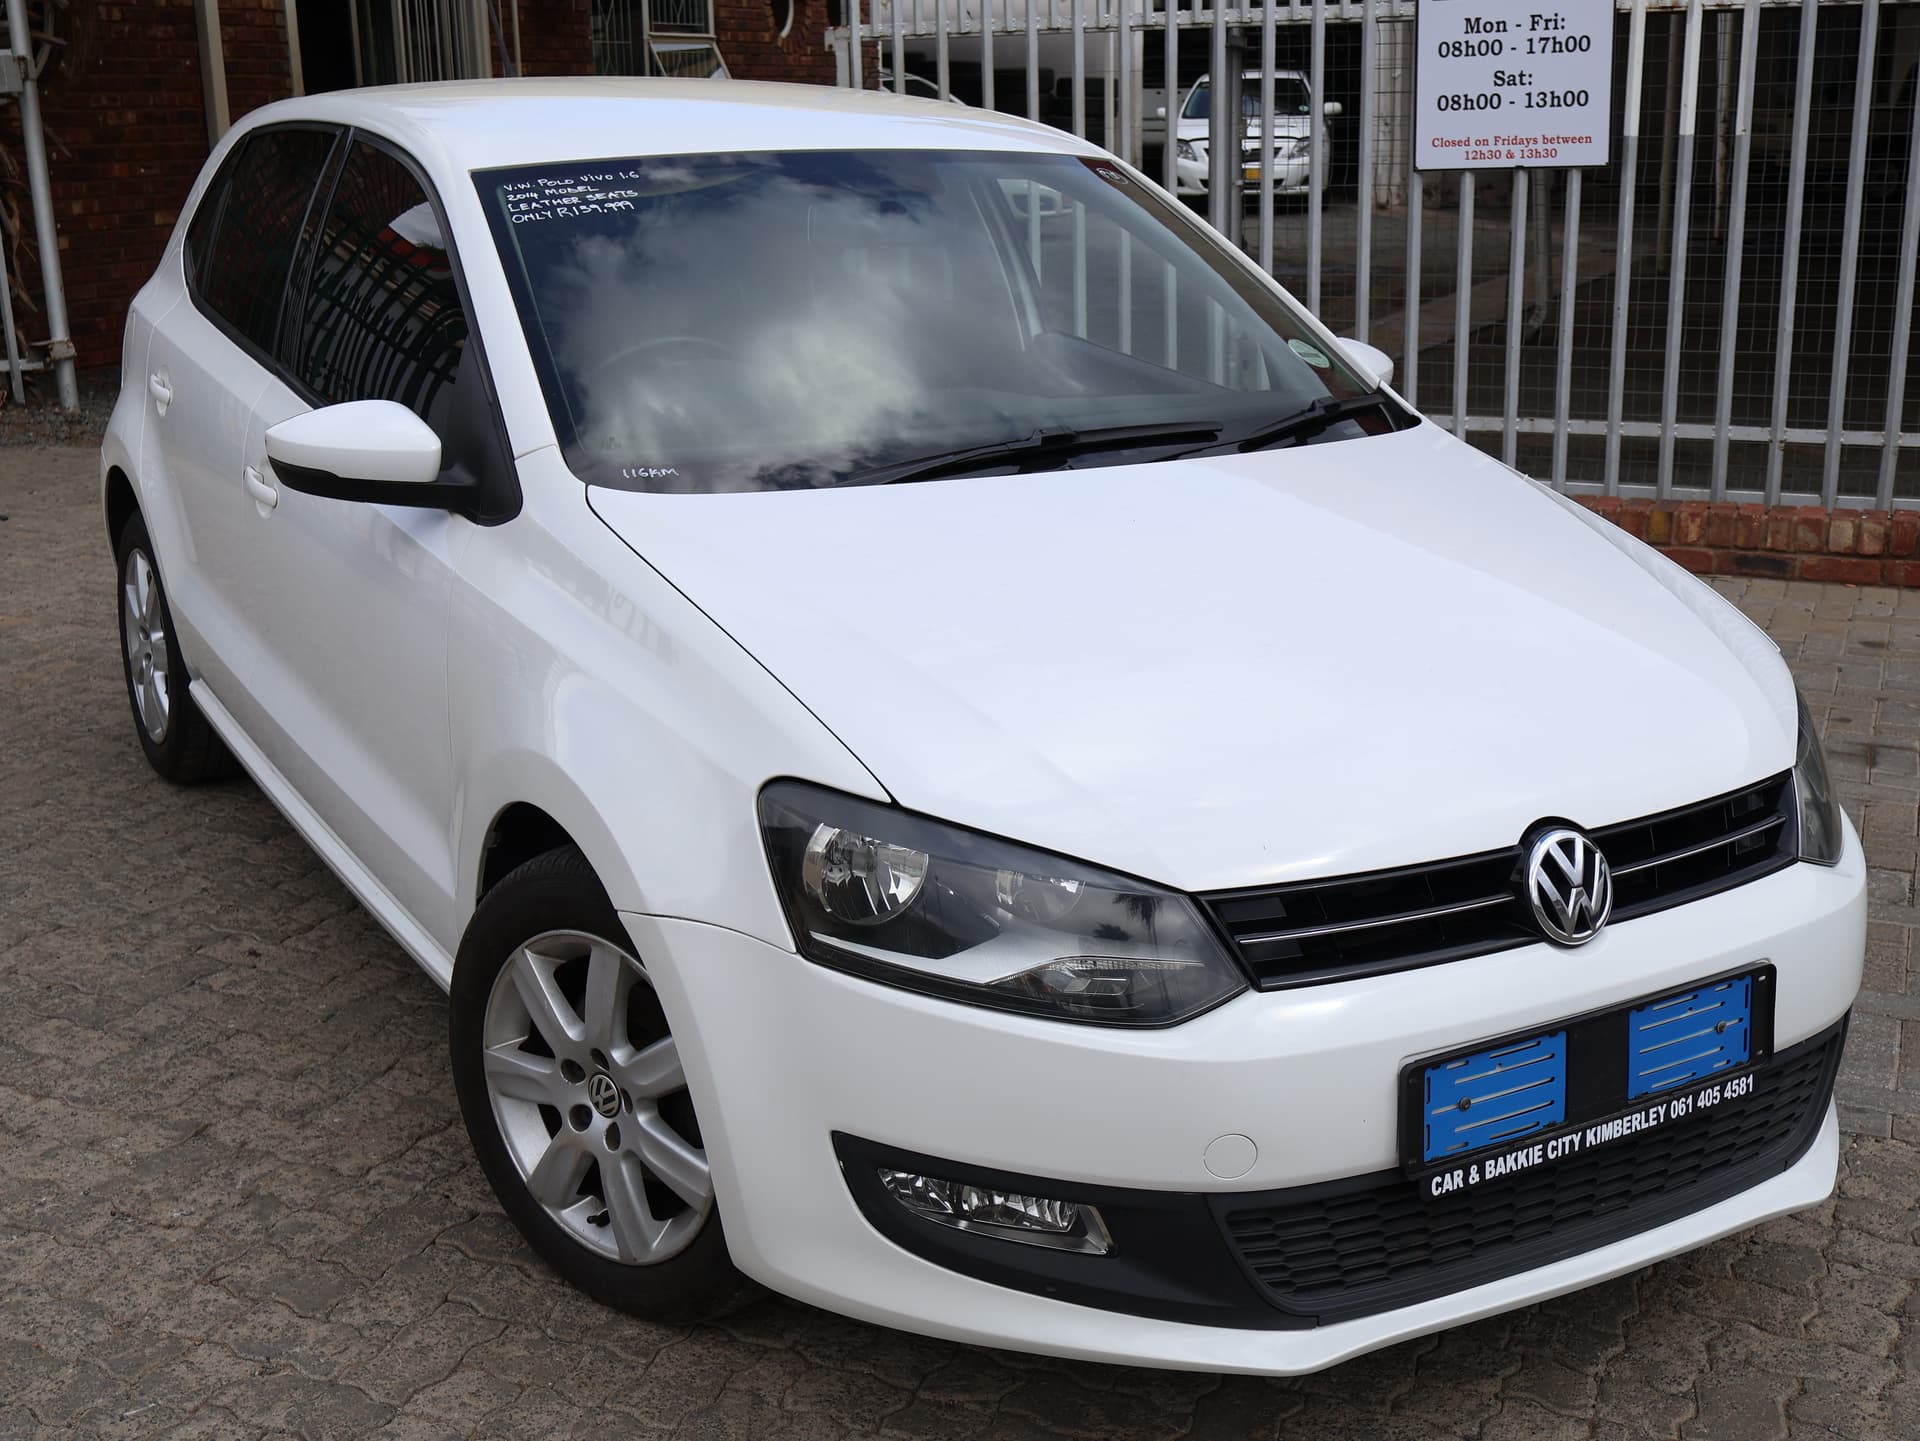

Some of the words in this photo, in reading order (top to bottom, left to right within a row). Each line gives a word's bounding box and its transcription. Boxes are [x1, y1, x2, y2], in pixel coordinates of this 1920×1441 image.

[1464, 17, 1508, 34] Mon
[1529, 13, 1565, 31] Fri:
[1438, 39, 1503, 58] 08h00
[1526, 35, 1591, 54] 17h00
[1493, 70, 1533, 87] Sat:
[1437, 93, 1501, 111] 08h00
[1525, 90, 1589, 109] 13h00
[1432, 136, 1470, 148] Closed
[1493, 135, 1539, 148] Fridays
[1542, 134, 1593, 145] between
[1464, 150, 1502, 160] 12h30
[1505, 150, 1515, 160] &
[1520, 148, 1558, 159] 13h30
[619, 171, 640, 180] 1.6
[507, 192, 539, 201] 2014
[545, 185, 600, 196] MODEL
[508, 197, 582, 212] LEATHER
[586, 190, 639, 201] SEATS
[512, 210, 552, 223] ONLY
[1431, 1169, 1464, 1196] CAR
[1468, 1164, 1480, 1185] &
[1485, 1144, 1543, 1180] BAKKIE
[1547, 1131, 1582, 1160] CITY
[1586, 1104, 1667, 1148] KIMBERLEY
[1670, 1094, 1693, 1119] 061
[1697, 1085, 1721, 1109] 405
[1723, 1074, 1754, 1100] 4581
